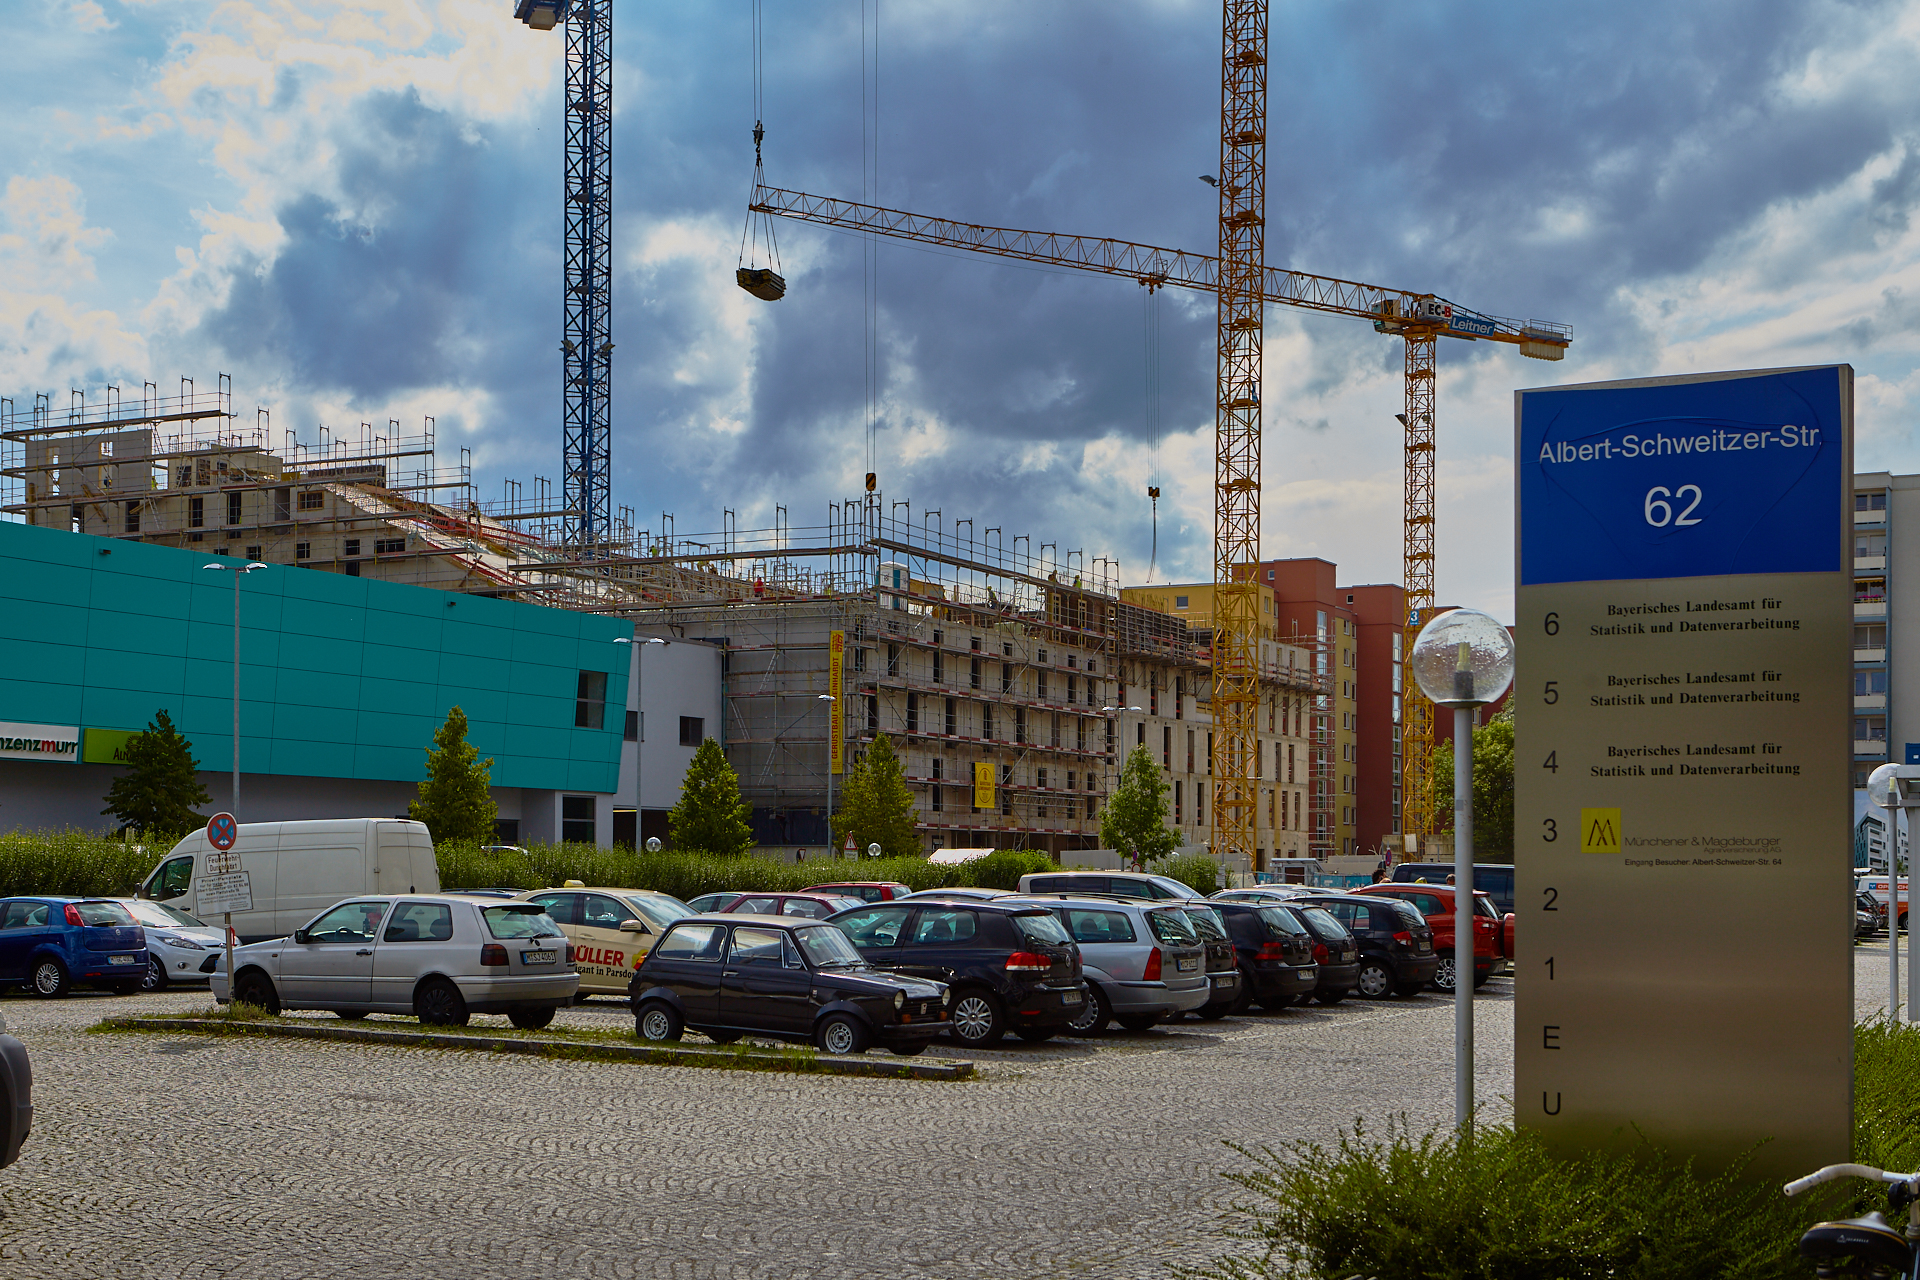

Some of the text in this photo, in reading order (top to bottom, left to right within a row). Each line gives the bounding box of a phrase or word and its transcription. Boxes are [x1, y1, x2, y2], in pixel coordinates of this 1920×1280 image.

[1451, 318, 1493, 335] Leitner
[1644, 484, 1702, 527] 62
[1607, 598, 1782, 617] Bayerisches Landesamt für
[1544, 612, 1559, 636] 6
[1590, 617, 1800, 636] Statistik und Datenverarbeitung
[1607, 670, 1782, 688] Bayerisches Landesamt für
[1543, 681, 1559, 705] 5
[1590, 690, 1800, 706] Statistik und Datenverarbeitung
[1607, 743, 1782, 759] Bayerisches Landesamt für
[1543, 750, 1559, 774] 4
[1590, 762, 1800, 777] Statistik und Datenverarbeitung
[1542, 818, 1558, 842] 3
[1625, 836, 1781, 849] Münchener & Magdeburger
[208, 855, 240, 864] Feurehr-
[1624, 858, 1782, 867] Eingang Besucher: Albert-Schweitzer-Str. 64
[1542, 887, 1559, 911] 2
[575, 945, 625, 967] ÜLLER
[575, 964, 594, 974] igant
[596, 966, 604, 976] in
[1544, 956, 1554, 980] 1
[1543, 1025, 1560, 1050] E
[1543, 1091, 1561, 1116] U
